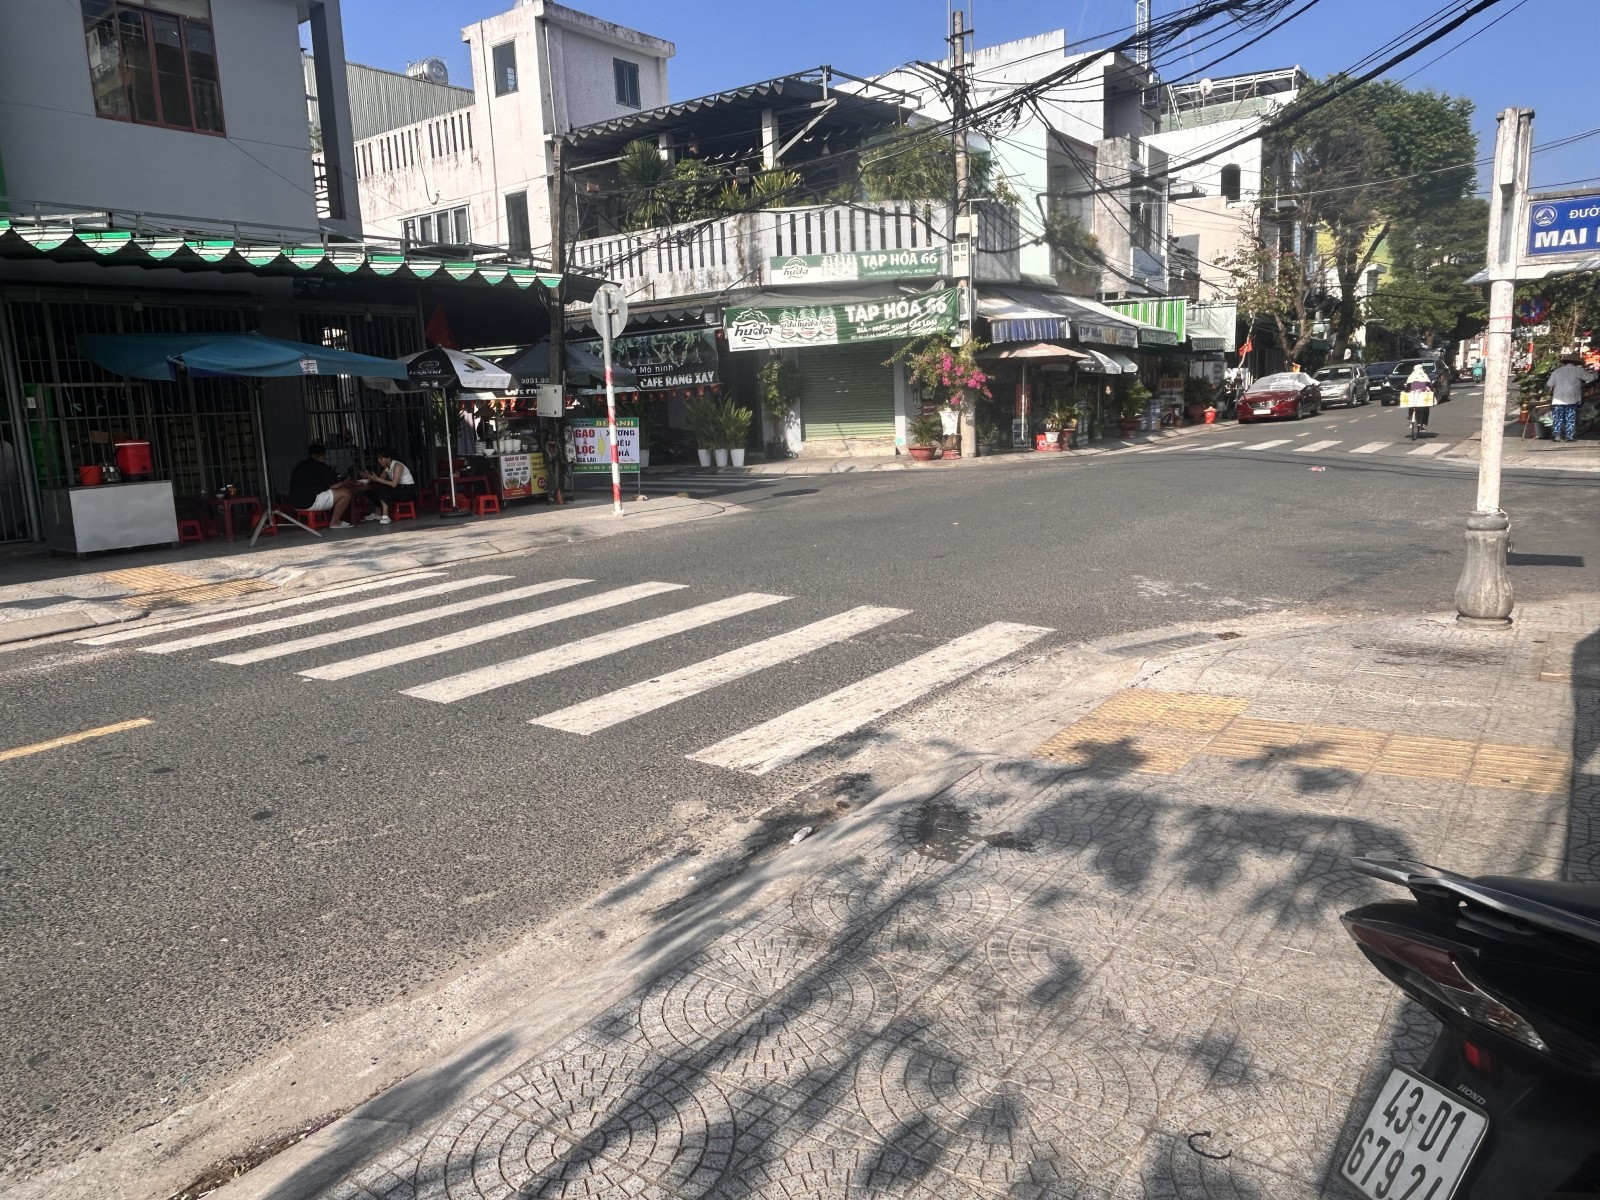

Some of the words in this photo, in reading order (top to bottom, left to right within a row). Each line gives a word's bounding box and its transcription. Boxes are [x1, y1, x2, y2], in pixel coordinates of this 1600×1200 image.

[1535, 228, 1587, 248] MAI
[861, 254, 887, 270] TẠP
[890, 251, 918, 266] HÓA
[921, 252, 938, 264] 66
[844, 304, 879, 326] TẠP
[884, 297, 921, 319] HÓA
[925, 297, 947, 314] 66
[734, 321, 773, 337] huda
[640, 377, 664, 388] CAFE
[666, 374, 692, 386] RANG
[694, 370, 714, 383] XAY
[1383, 1079, 1467, 1163] 43-D1
